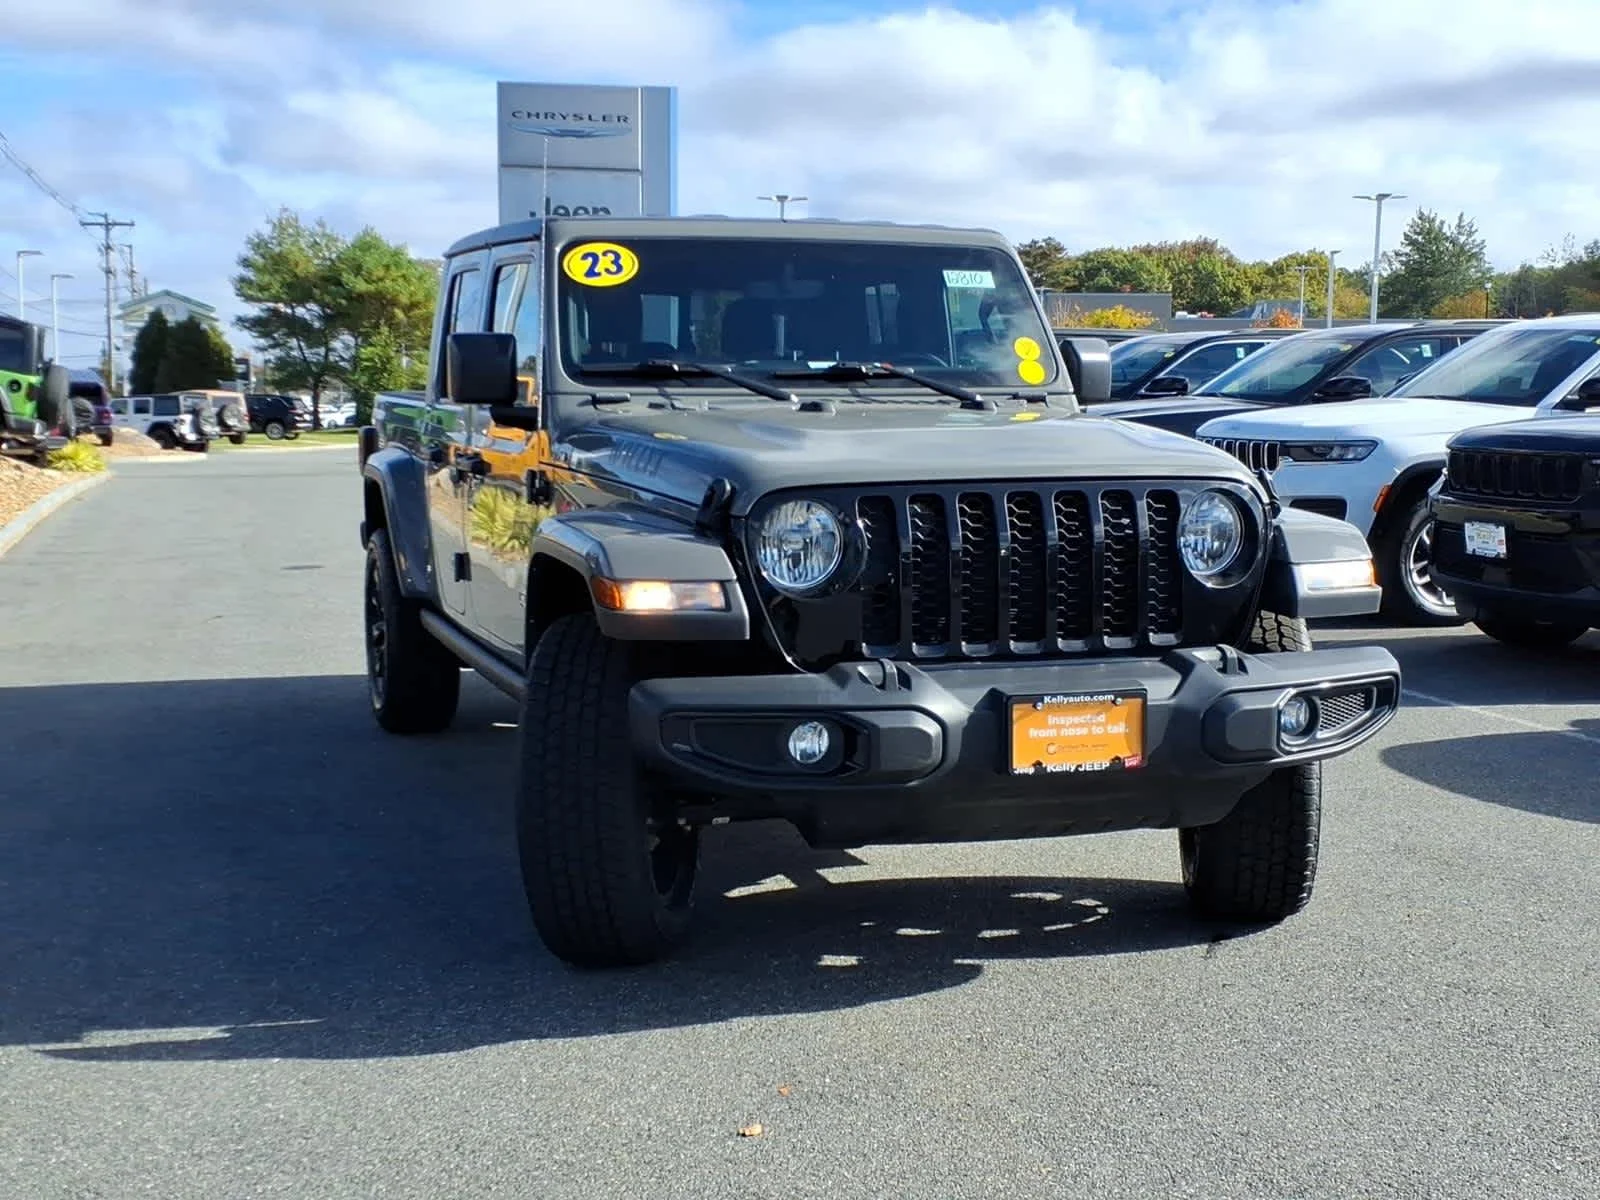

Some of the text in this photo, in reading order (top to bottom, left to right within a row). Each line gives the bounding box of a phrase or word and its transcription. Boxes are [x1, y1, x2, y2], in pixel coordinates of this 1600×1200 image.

[511, 110, 630, 124] CHRYSLER
[580, 249, 624, 278] 23
[1043, 694, 1115, 705] Kellyauto.com
[1048, 712, 1106, 726] Inspected
[1029, 728, 1057, 738] from
[1060, 726, 1089, 737] nose
[1091, 725, 1105, 735] to
[1046, 761, 1110, 773] Kelly JEEP
